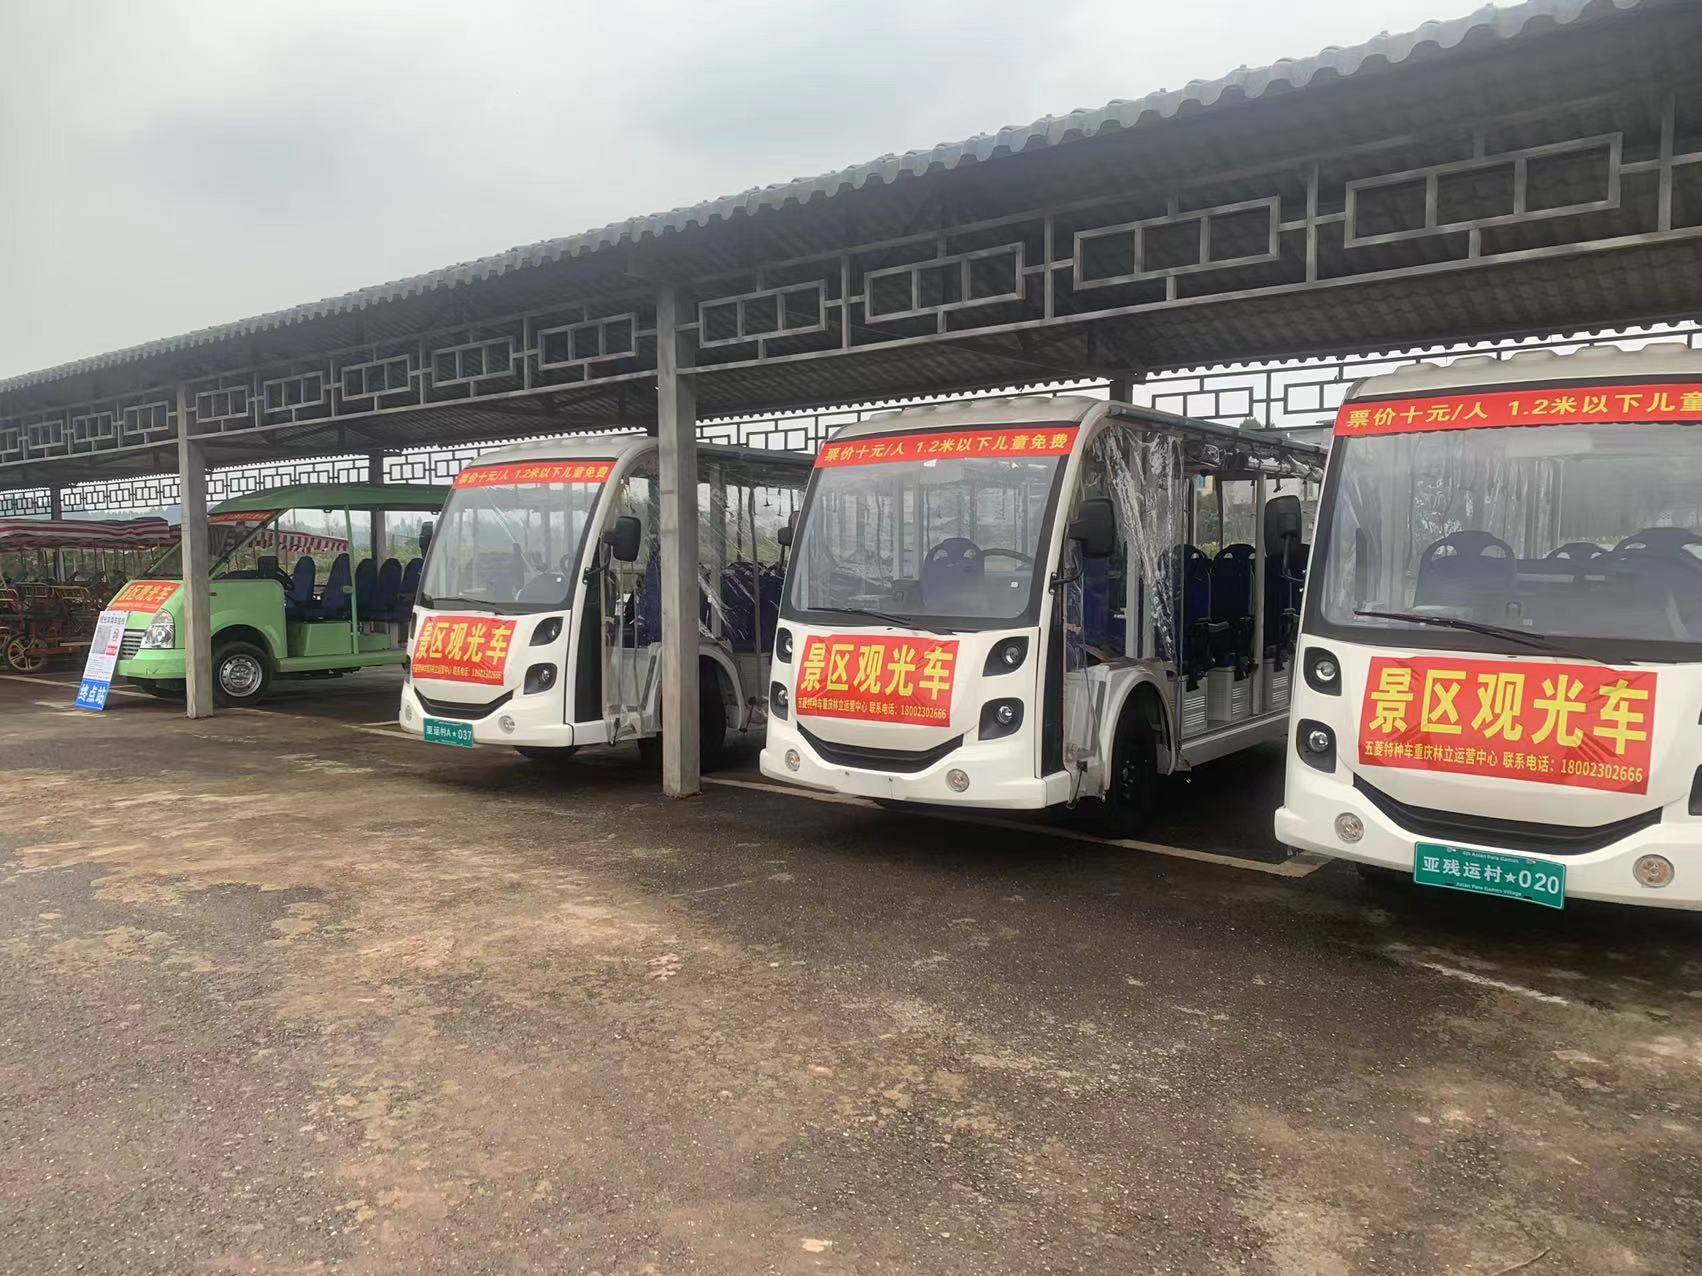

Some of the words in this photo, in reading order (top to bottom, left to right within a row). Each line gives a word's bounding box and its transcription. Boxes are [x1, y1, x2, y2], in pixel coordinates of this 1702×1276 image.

[1346, 400, 1488, 428] 票价十元/人
[824, 442, 904, 462] 票价十元/人
[916, 433, 1067, 453] 1.2米以下儿童免费
[415, 621, 513, 665] 景区观光车
[800, 641, 954, 700] 景区观光车
[1368, 667, 1650, 756] 景区观光车
[1364, 741, 1499, 768] 五菱特种车重庆林立运营中心
